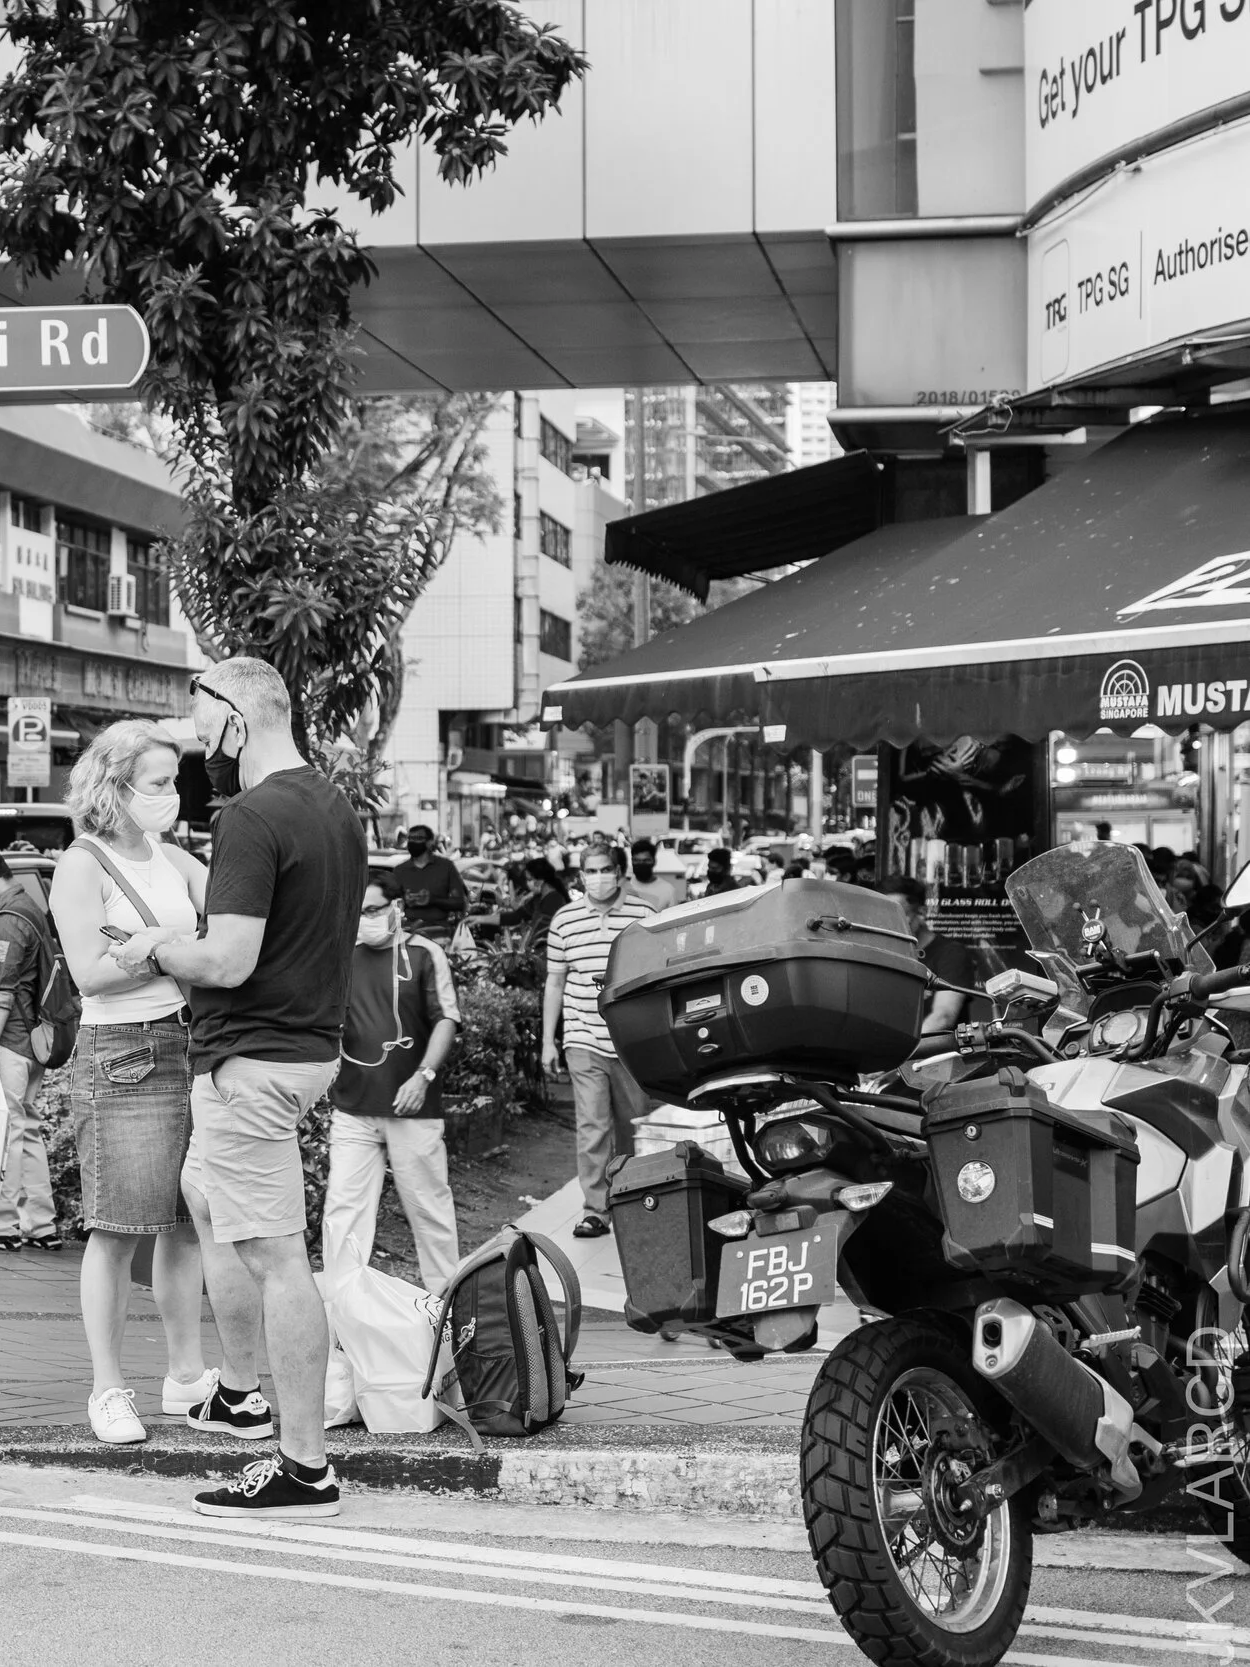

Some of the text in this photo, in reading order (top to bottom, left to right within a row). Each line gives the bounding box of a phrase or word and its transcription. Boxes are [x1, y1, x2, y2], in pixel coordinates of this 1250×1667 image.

[1039, 0, 1206, 129] Get your TPG
[1078, 271, 1104, 315] TPG
[1108, 261, 1130, 302] SG
[40, 317, 109, 366] Rd
[1100, 694, 1149, 708] MUSTAFA
[1100, 707, 1149, 720] SINGAPORE
[1156, 680, 1250, 716] MUST
[747, 1241, 809, 1280] FBJ
[740, 1272, 813, 1312] 162P
